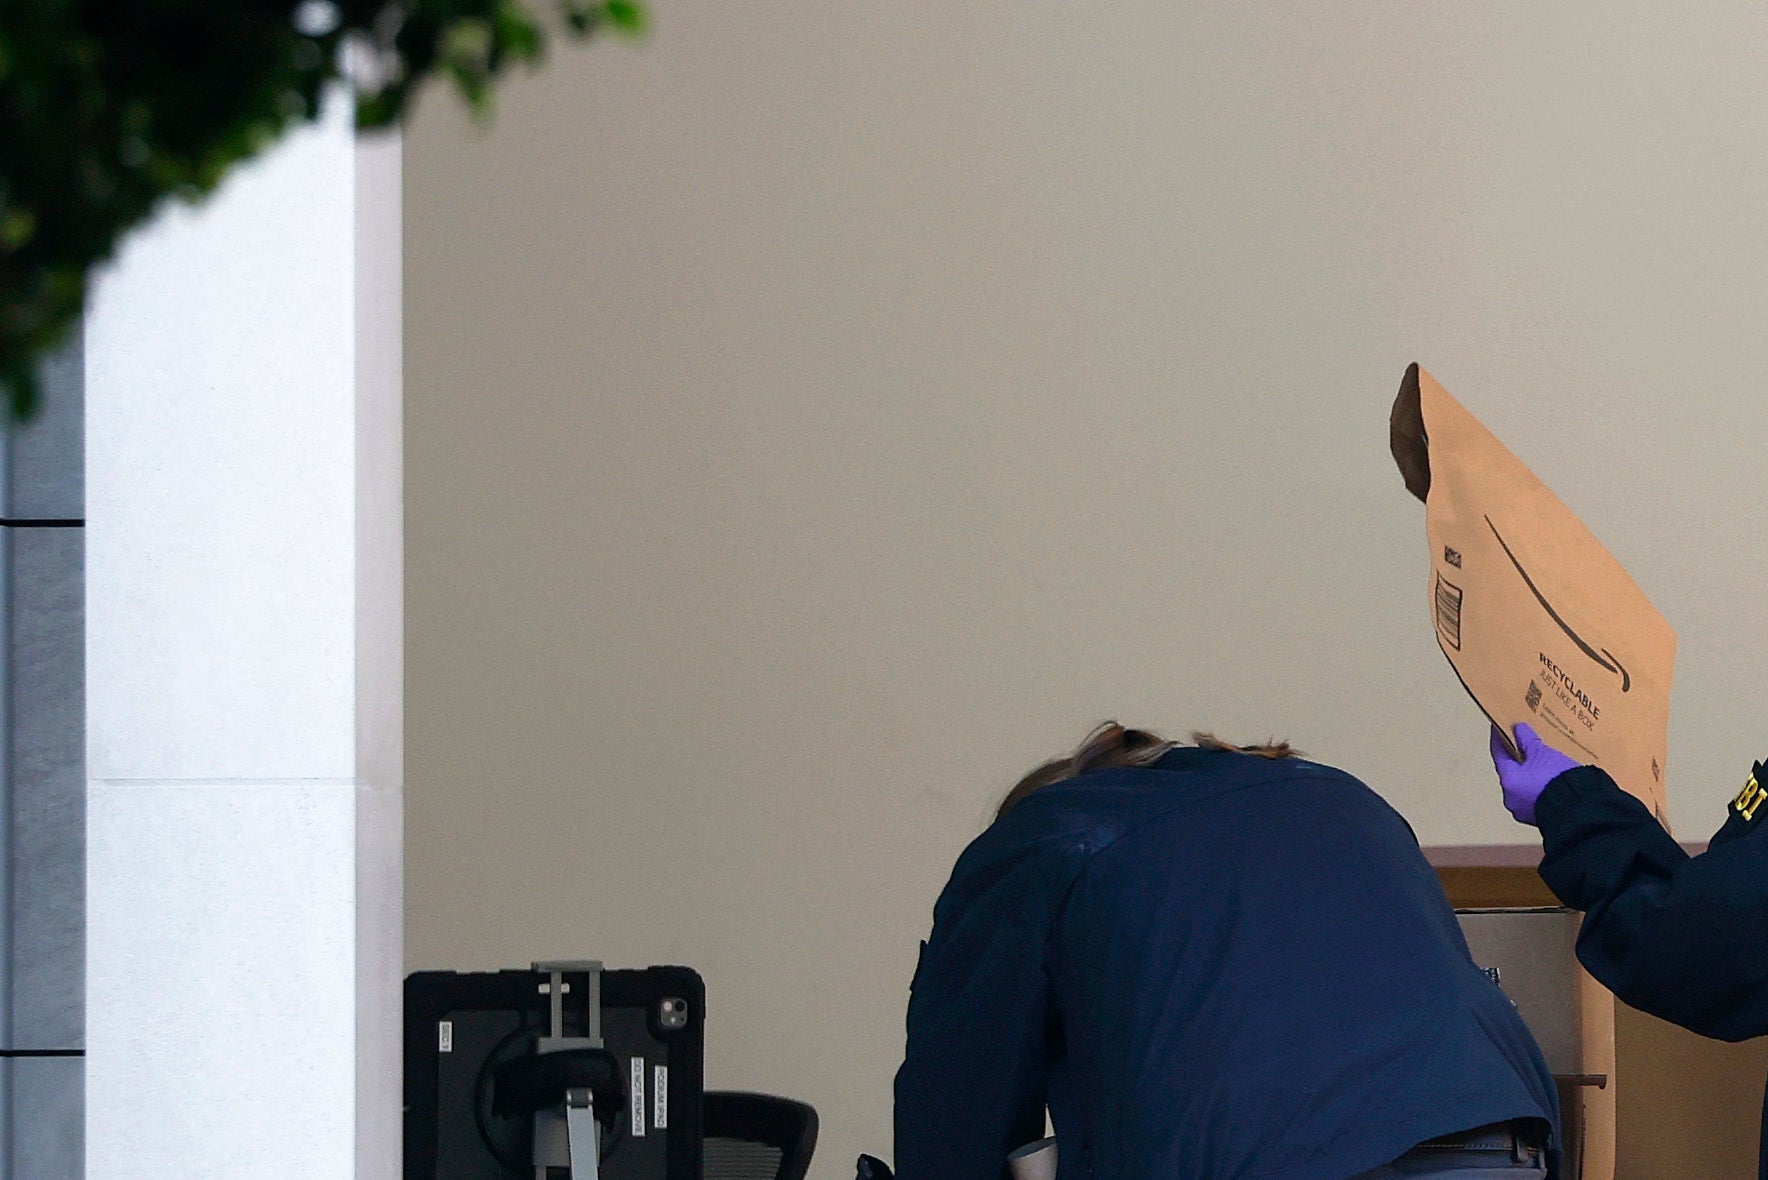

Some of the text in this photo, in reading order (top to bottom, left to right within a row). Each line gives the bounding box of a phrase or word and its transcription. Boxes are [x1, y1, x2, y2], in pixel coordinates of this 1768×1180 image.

[1539, 652, 1600, 720] RECYCLABLE
[1556, 687, 1571, 708] LIKE
[1577, 711, 1595, 732] BOX
[1735, 771, 1768, 821] BI
